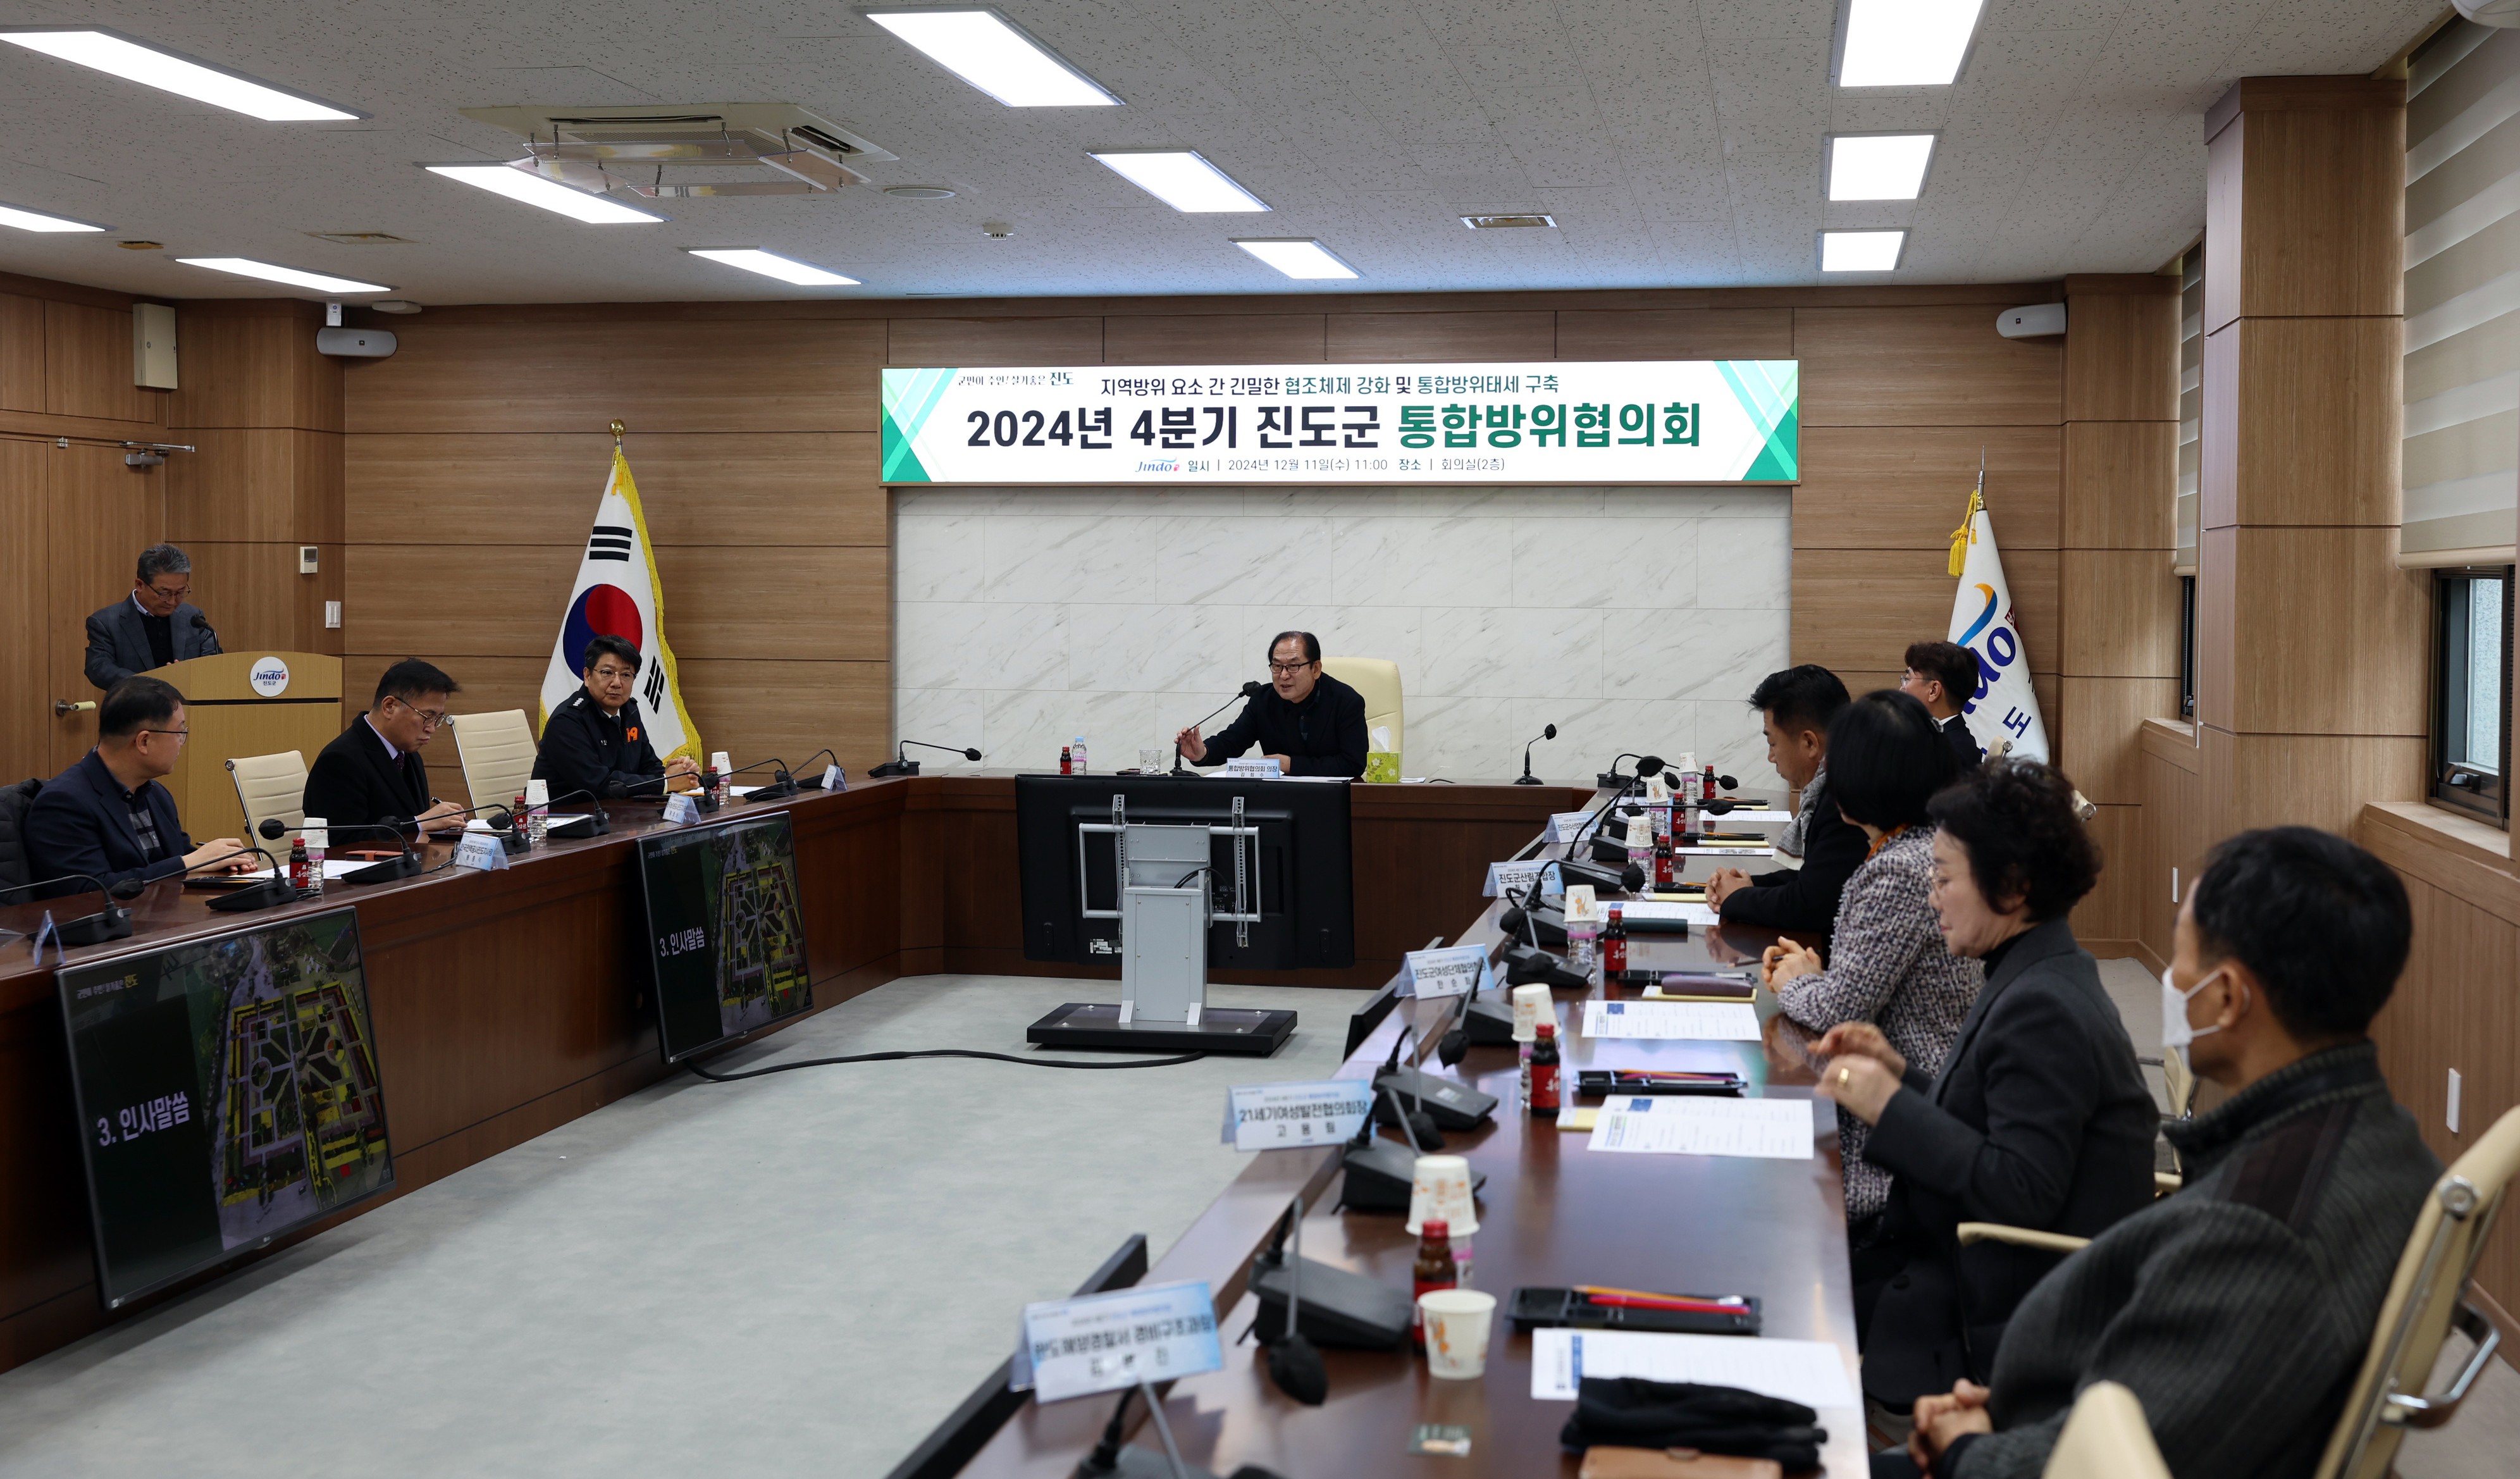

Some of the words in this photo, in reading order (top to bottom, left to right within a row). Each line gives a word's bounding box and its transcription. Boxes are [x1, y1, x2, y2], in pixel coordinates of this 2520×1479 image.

[958, 376, 984, 386] 군민이
[1012, 376, 1046, 386] 살기좋은
[1049, 372, 1074, 386] 진도
[1101, 378, 1165, 396] 지역방위
[1171, 378, 1203, 395] 요소
[1209, 378, 1225, 395] 간
[1230, 377, 1280, 395] 긴밀한
[1285, 376, 1350, 395] 협조체제
[1357, 376, 1391, 395] 강화
[1396, 376, 1411, 394] 및
[1417, 375, 1519, 395] 통합방위태세
[1525, 374, 1559, 393] 구축
[967, 407, 1112, 449] 2024년
[1130, 406, 1237, 449] 4분기
[1257, 405, 1380, 449] 진도군
[1398, 402, 1700, 449] 통합방위협의회
[1135, 461, 1173, 473] Jindo
[1188, 460, 1209, 472] 일시
[1228, 459, 1268, 471] 2024년
[1274, 459, 1299, 471] 12월
[1304, 458, 1350, 471] 11일(수)
[1355, 459, 1388, 470] 11:00
[1399, 459, 1421, 471] 장소
[1442, 457, 1505, 471] 회의실(2층)
[253, 672, 281, 681] Jindo
[659, 938, 669, 957] 3.
[670, 926, 705, 955] 인사말씀
[97, 1117, 118, 1147] 3.
[120, 1091, 190, 1142] 인사말씀
[1238, 1099, 1368, 1123] 21세기여성발전협의회장
